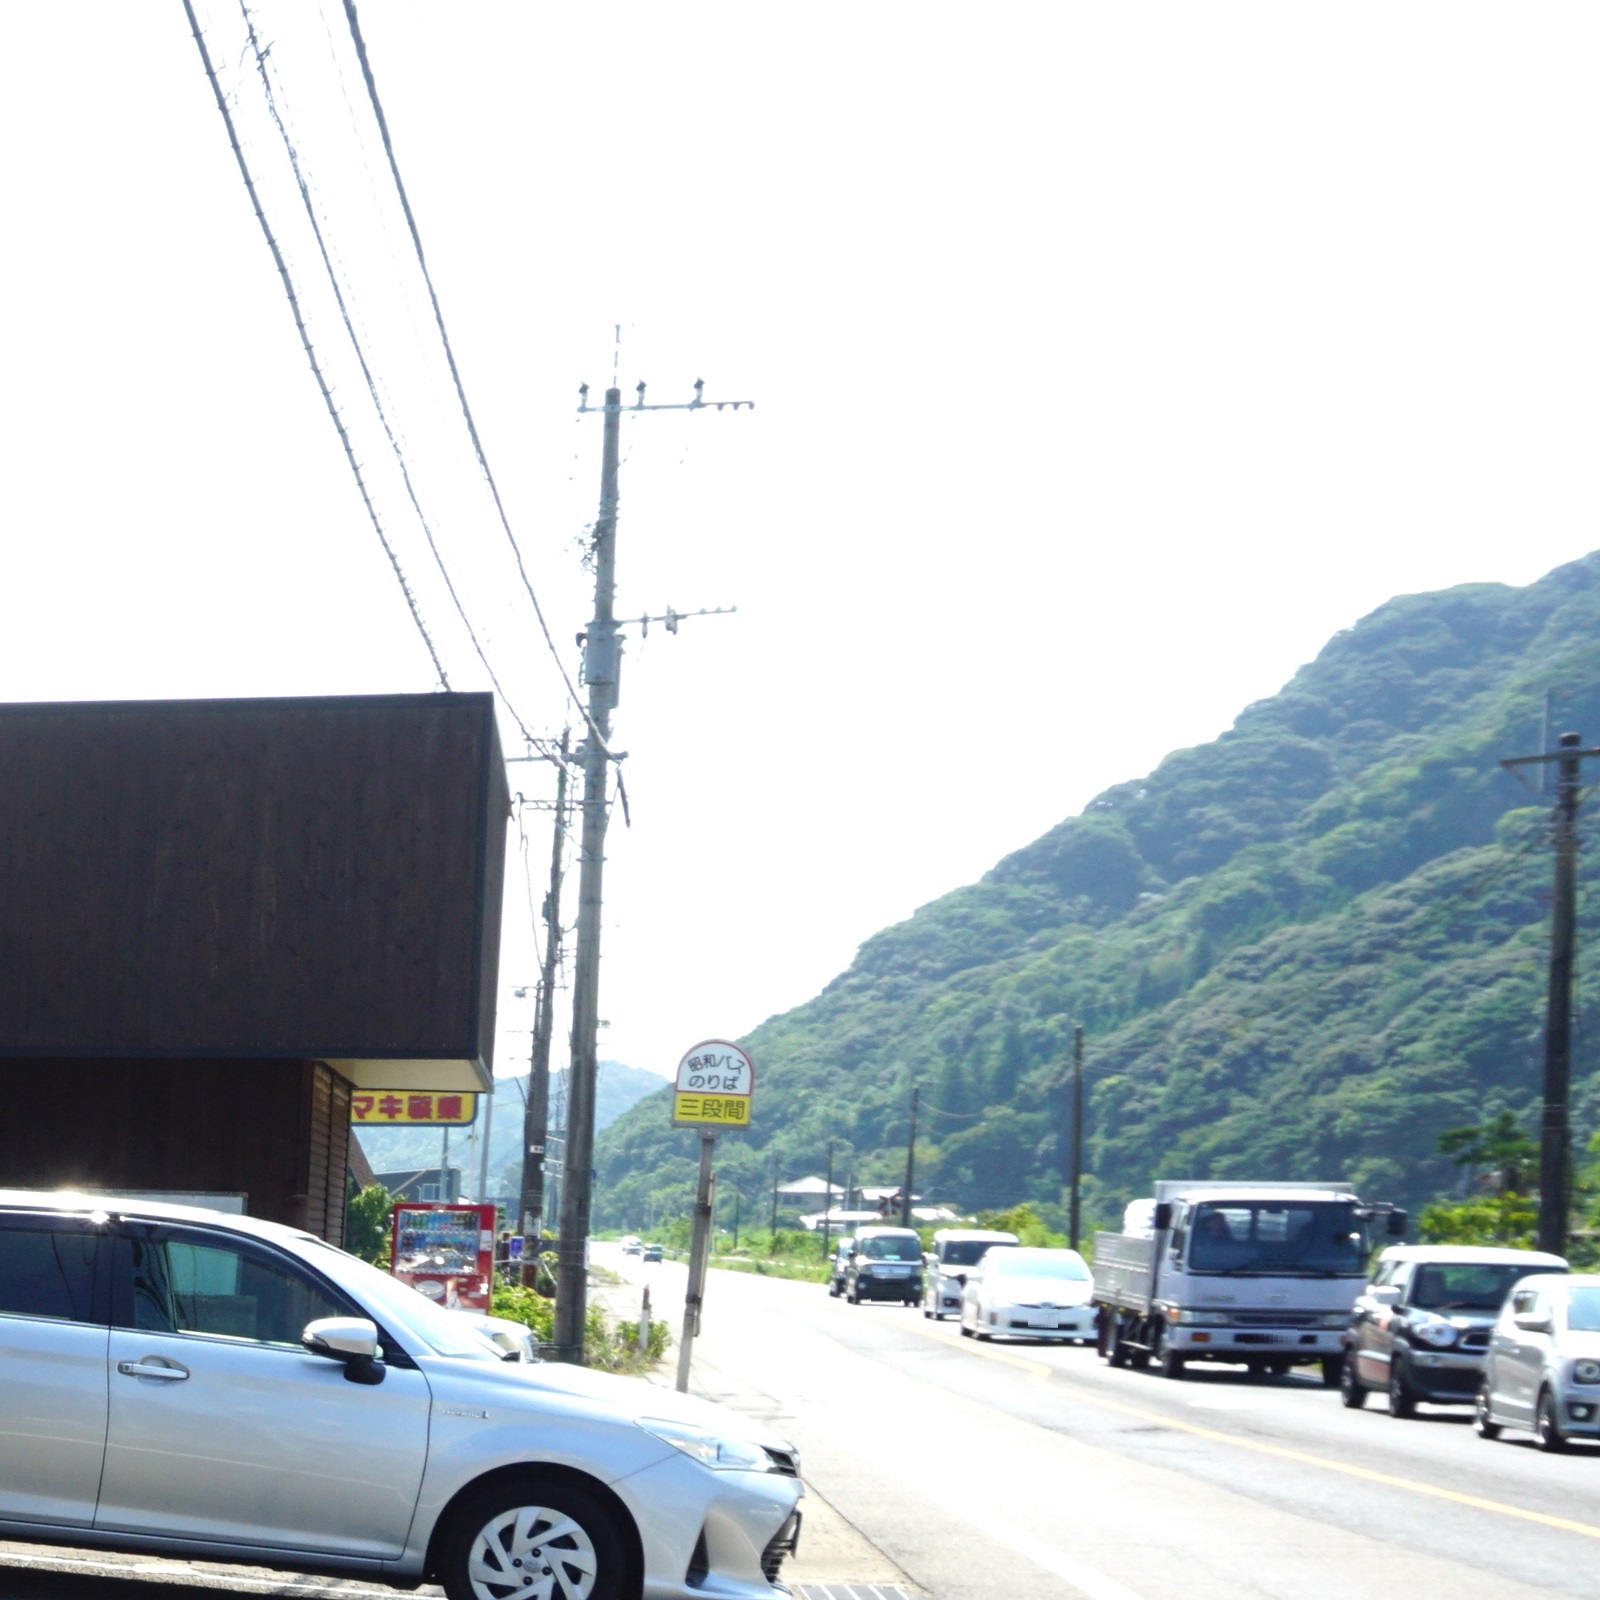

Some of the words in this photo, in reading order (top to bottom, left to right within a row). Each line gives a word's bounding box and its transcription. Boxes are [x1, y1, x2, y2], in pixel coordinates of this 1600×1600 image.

[687, 1053, 746, 1075] 昭和バス
[688, 1074, 740, 1091] のりば
[678, 1098, 746, 1120] 三段間
